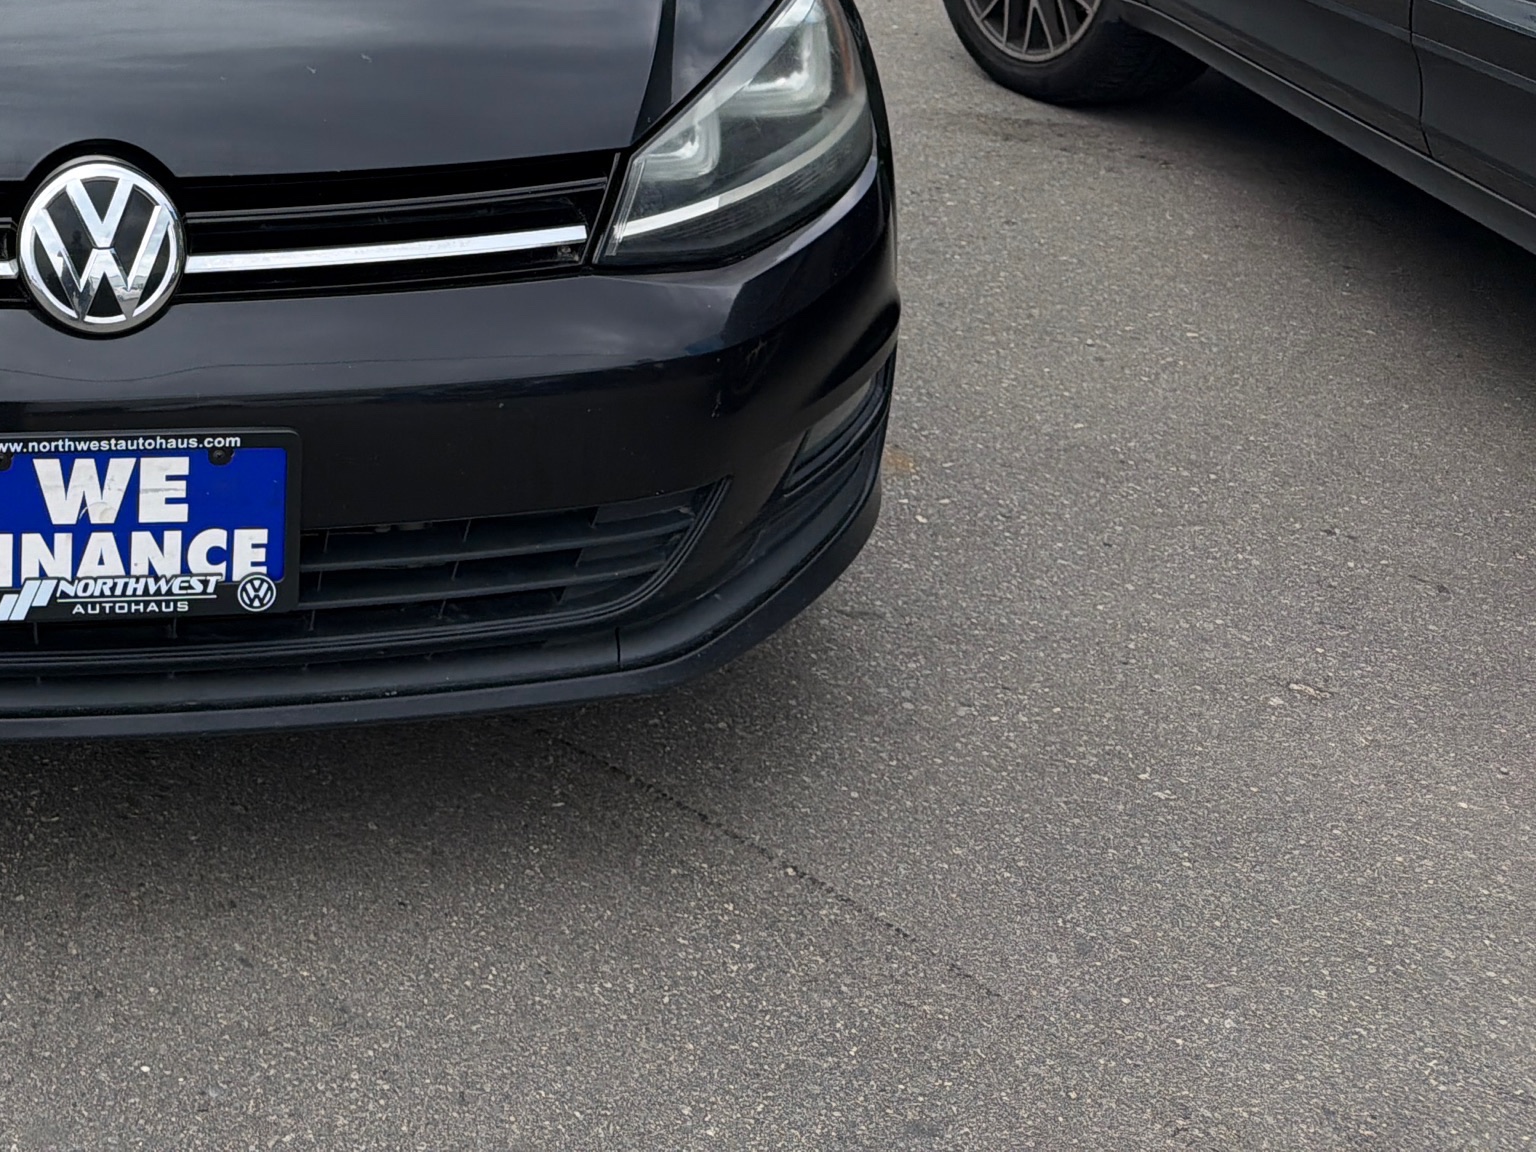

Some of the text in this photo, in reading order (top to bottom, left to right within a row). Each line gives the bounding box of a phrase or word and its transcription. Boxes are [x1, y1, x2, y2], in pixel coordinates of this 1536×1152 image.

[33, 456, 189, 524] WE
[56, 575, 222, 597] NORTHWEST
[72, 601, 189, 614] AUTOHAUS
